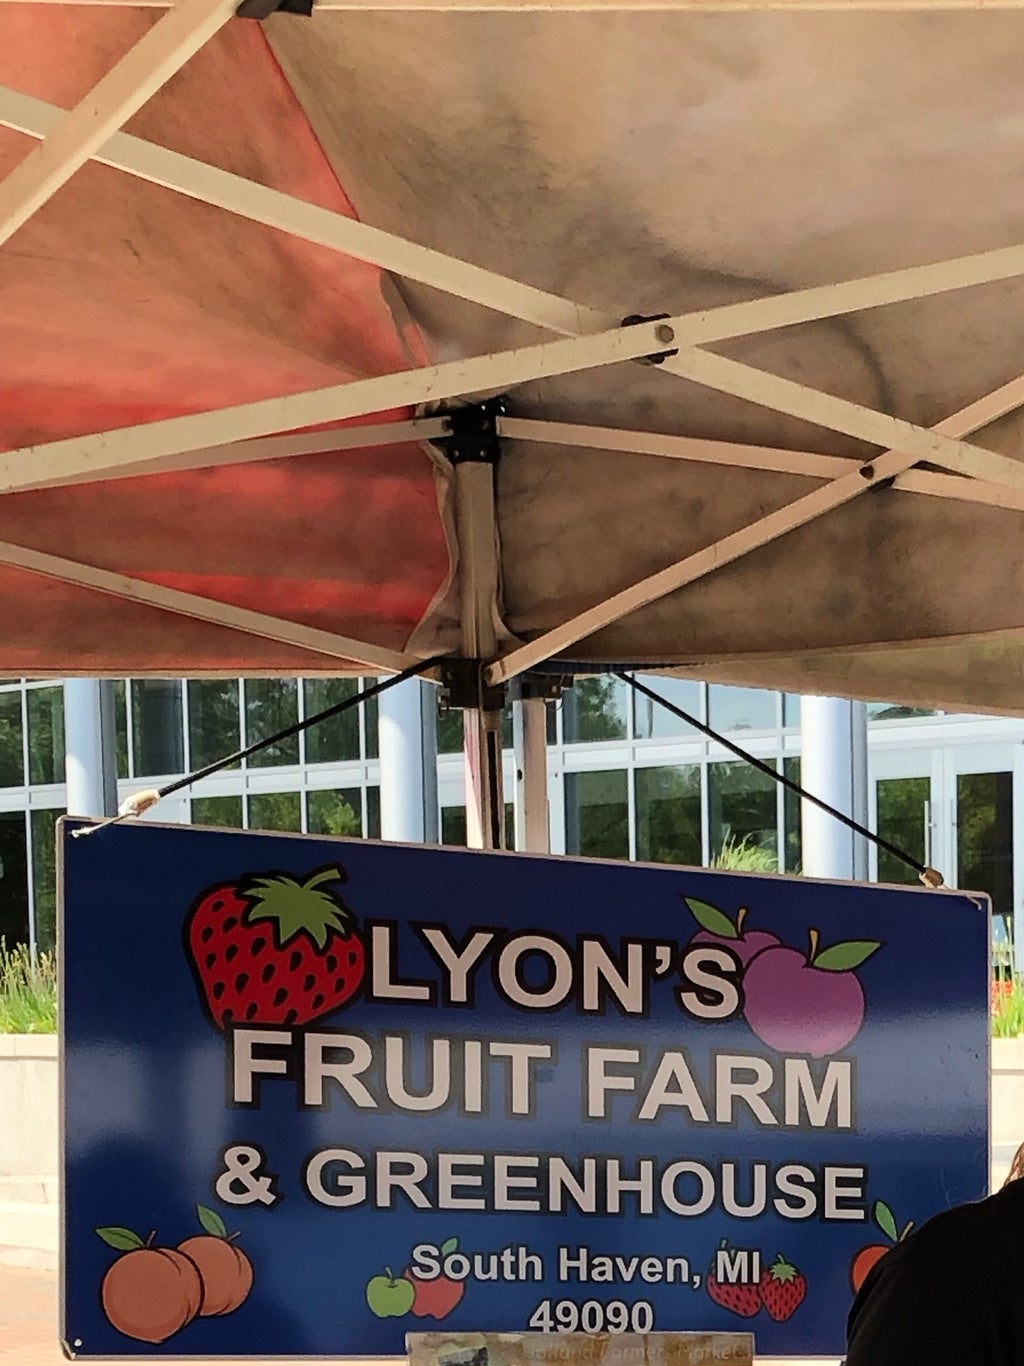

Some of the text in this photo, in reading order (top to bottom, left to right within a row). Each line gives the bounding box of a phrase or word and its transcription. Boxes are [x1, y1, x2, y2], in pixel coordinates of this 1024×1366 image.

[372, 926, 739, 1018] LYON'S
[233, 1029, 851, 1128] FRUIT FARM
[215, 1145, 865, 1219] & GREENHOUSE
[411, 1244, 760, 1288] South Haven, MI
[529, 1300, 653, 1333] 49090
